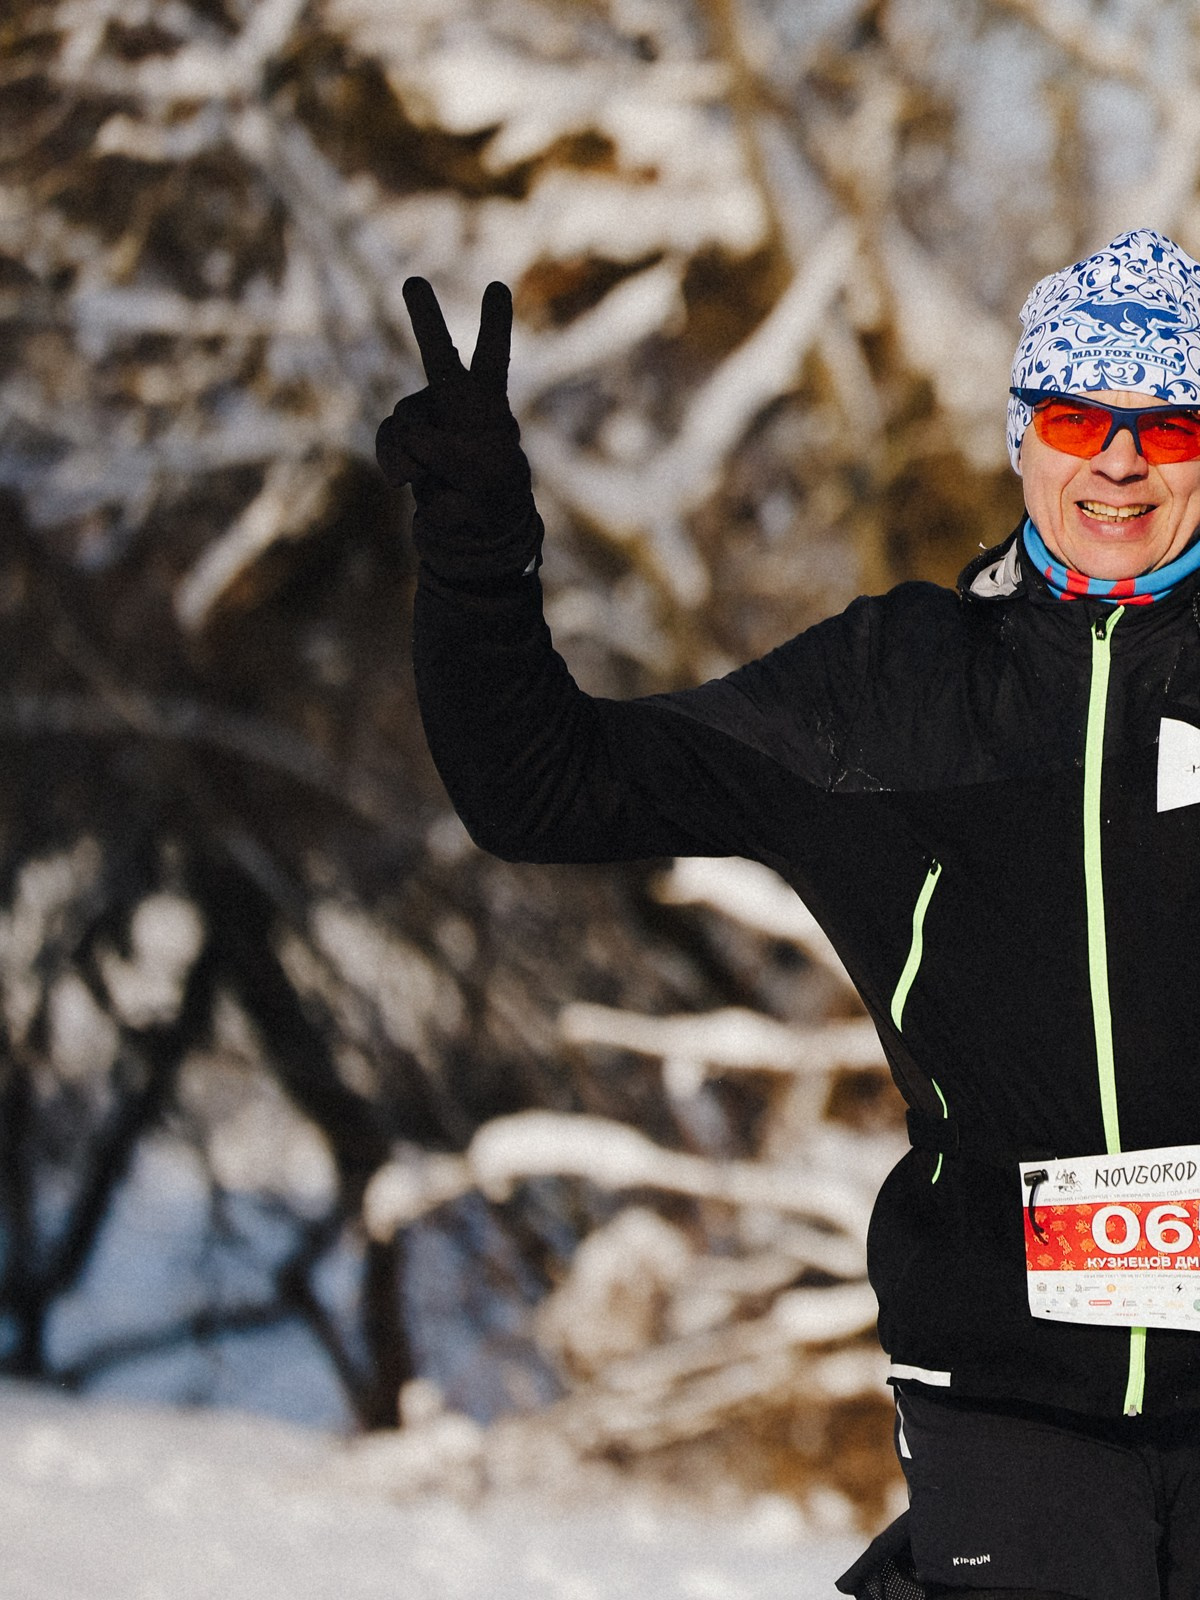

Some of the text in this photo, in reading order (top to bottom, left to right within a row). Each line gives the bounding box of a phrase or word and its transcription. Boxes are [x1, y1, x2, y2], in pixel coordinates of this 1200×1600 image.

[1072, 349, 1177, 369] MAD FOX ULTRA
[1095, 1161, 1197, 1188] NOVGOROD
[1087, 1256, 1171, 1269] КУЗНЕЦОВ
[952, 1554, 991, 1566] KIPRUN
